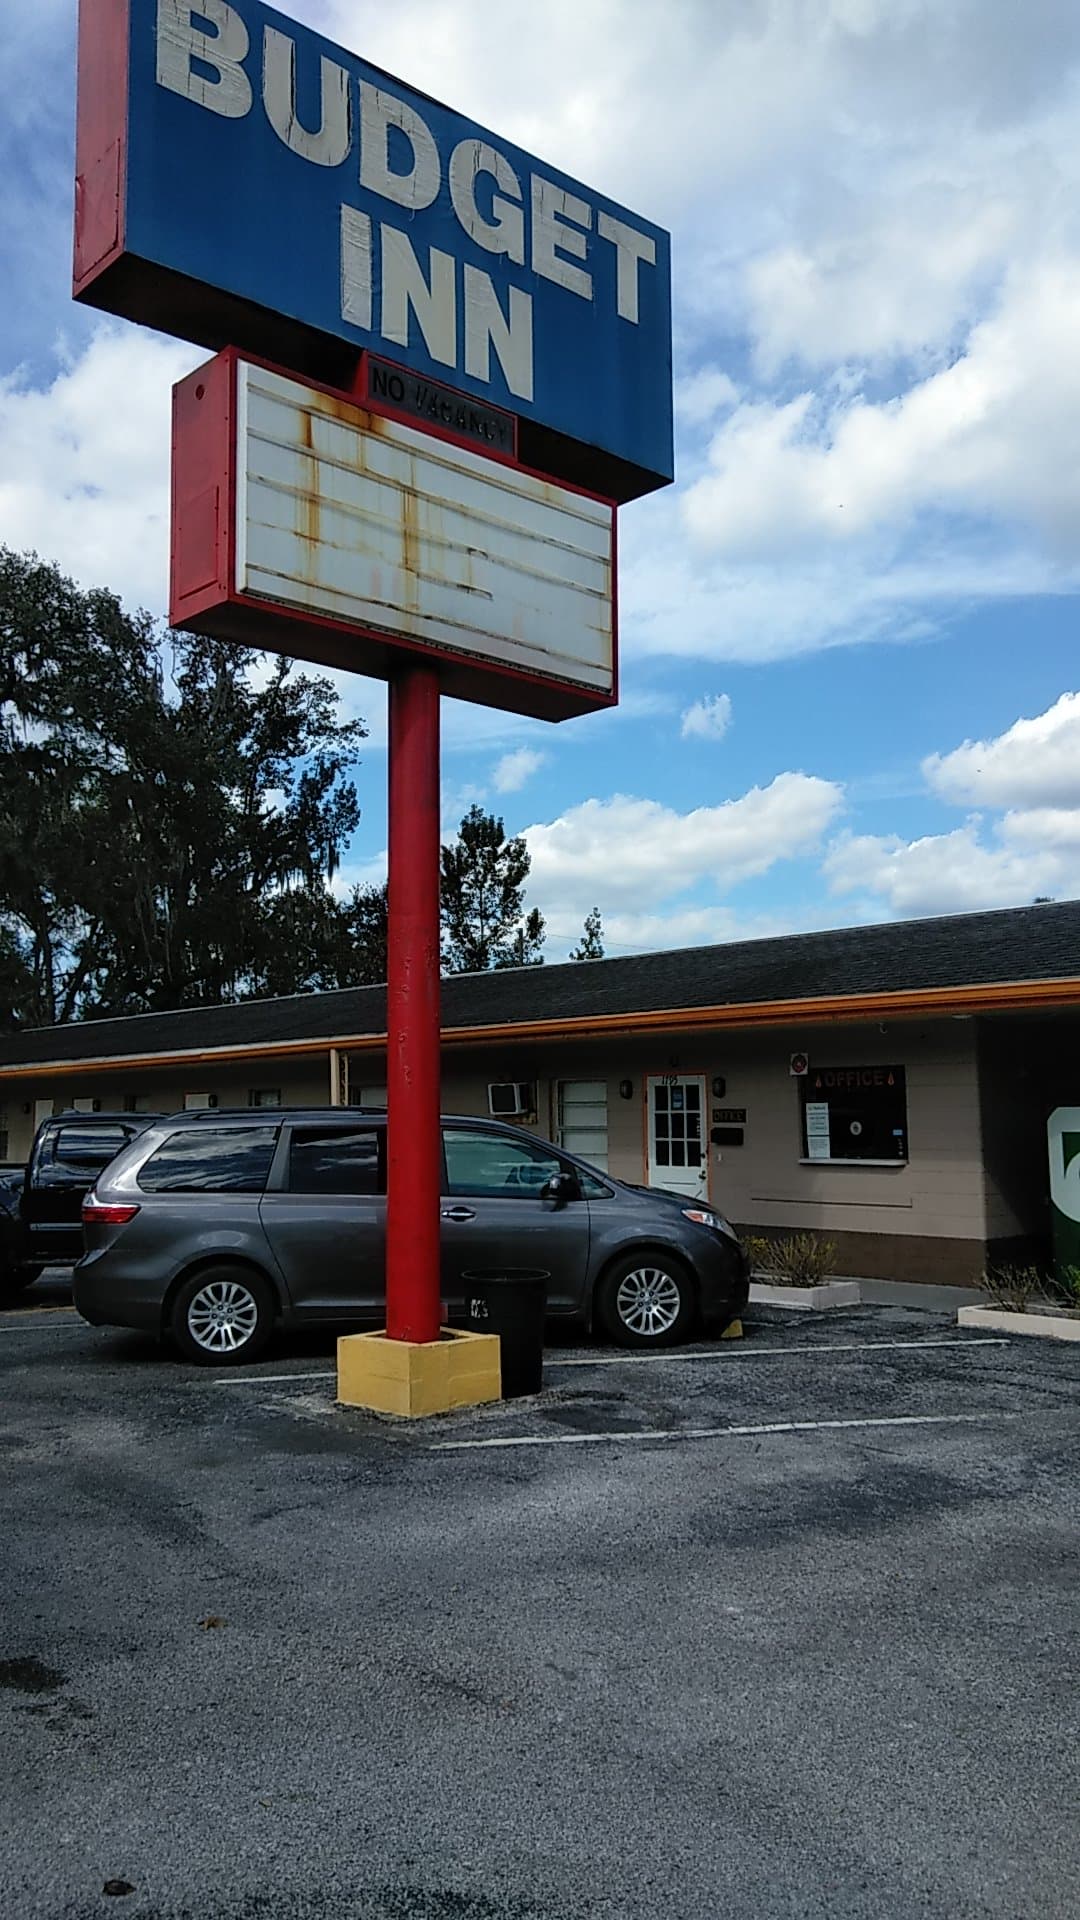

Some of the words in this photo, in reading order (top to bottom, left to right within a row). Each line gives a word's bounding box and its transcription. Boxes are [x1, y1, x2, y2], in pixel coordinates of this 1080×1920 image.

[155, 0, 657, 325] BUDGET
[340, 203, 534, 403] INN
[373, 368, 405, 402] NO
[416, 384, 506, 443] VACANCY
[824, 1071, 885, 1087] OFFICE
